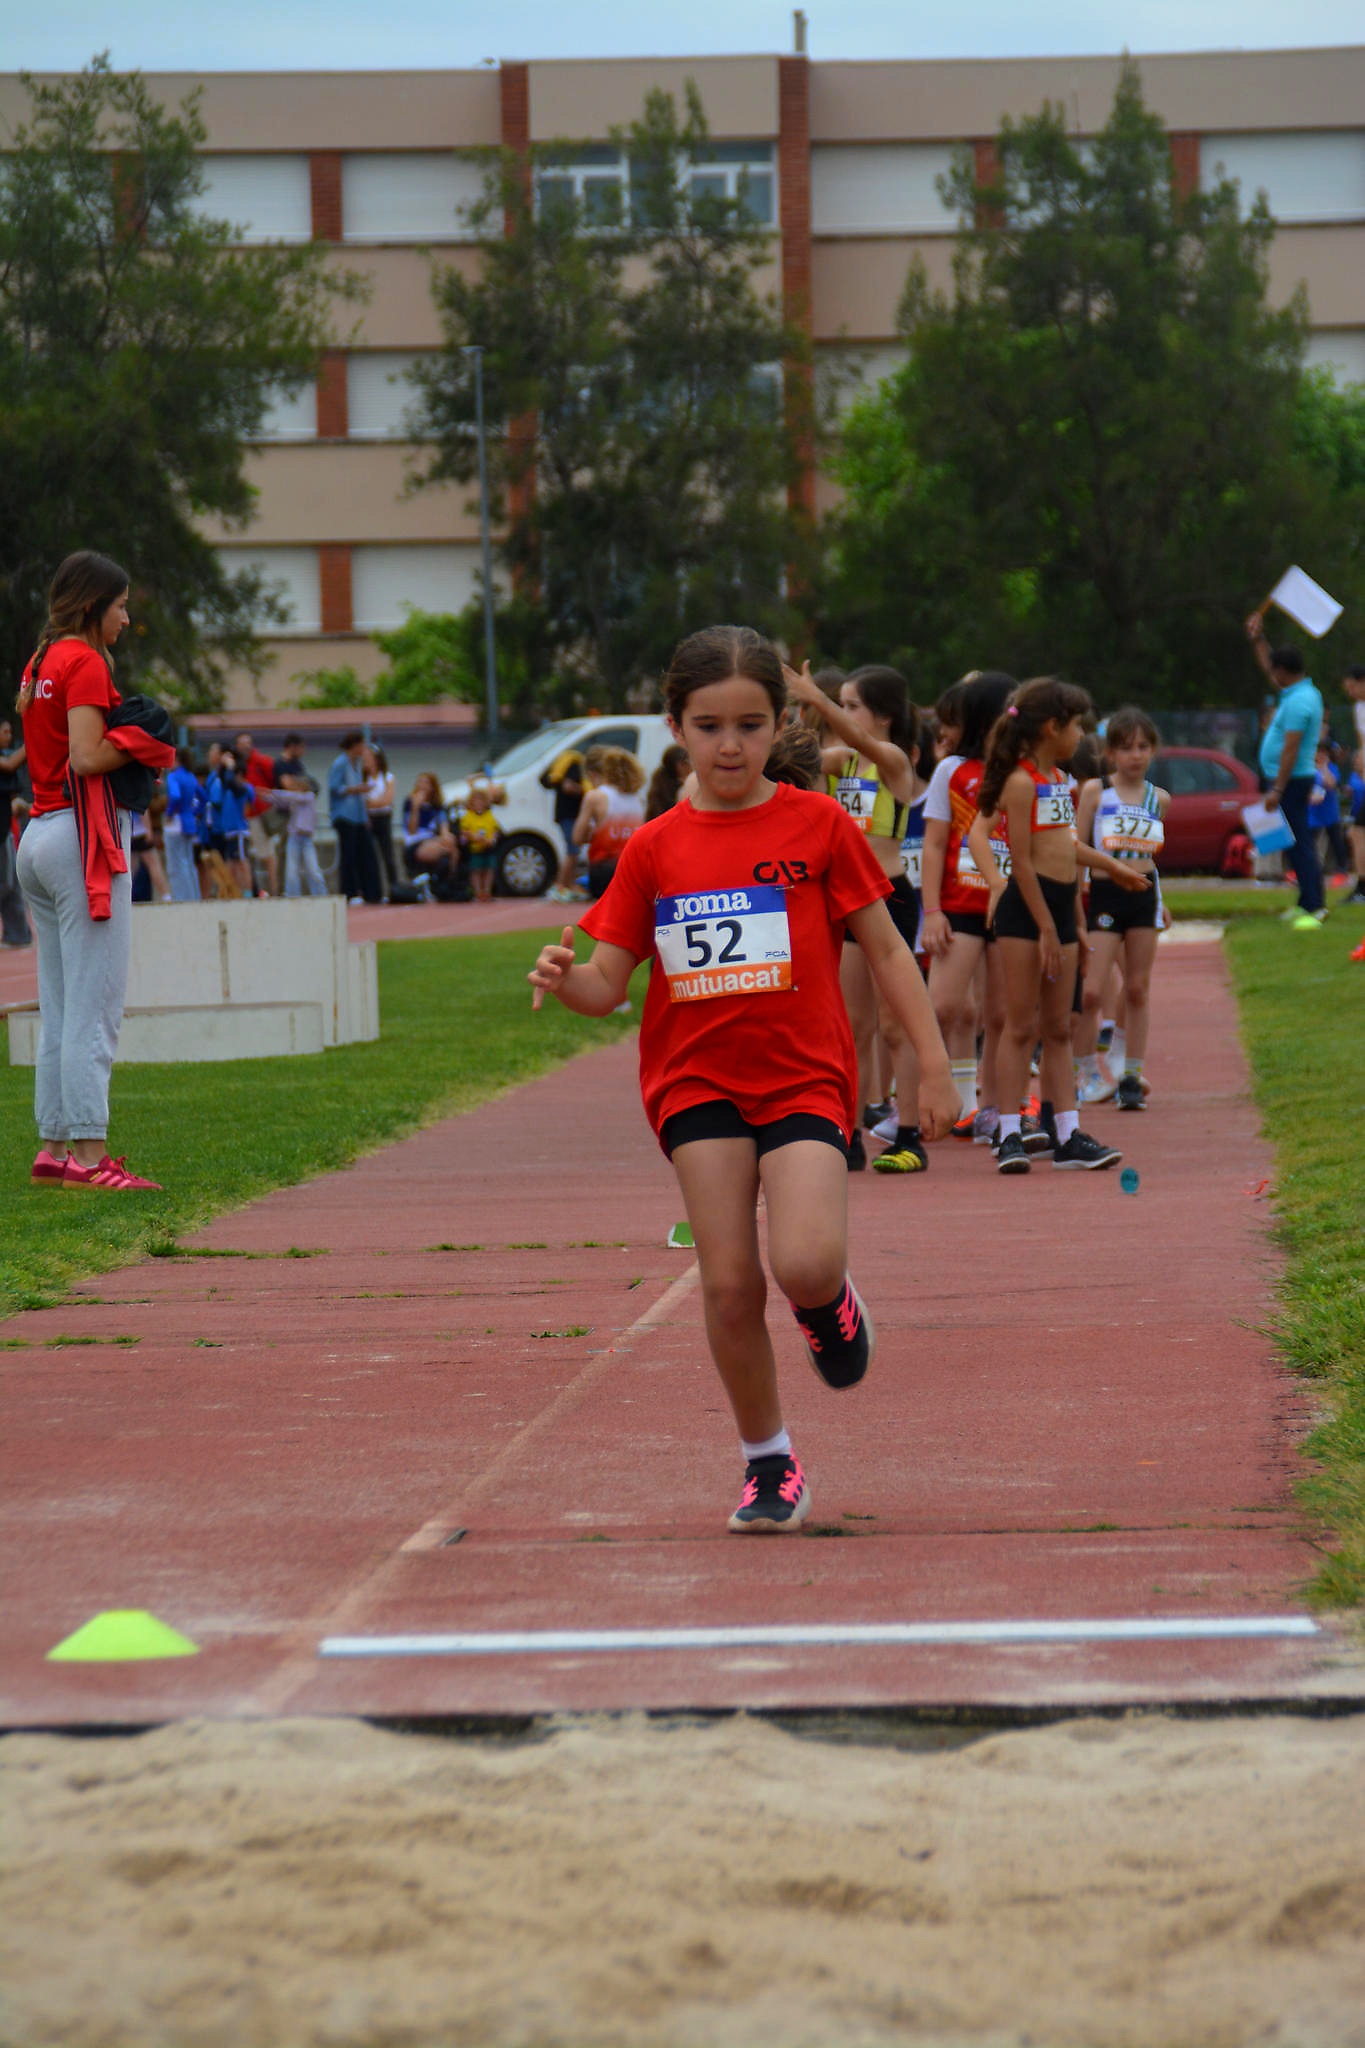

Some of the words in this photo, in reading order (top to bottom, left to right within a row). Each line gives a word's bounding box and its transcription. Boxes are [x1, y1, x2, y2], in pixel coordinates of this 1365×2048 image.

[1113, 816, 1153, 838] 377
[685, 919, 747, 968] 52
[671, 965, 782, 999] mutuacat
